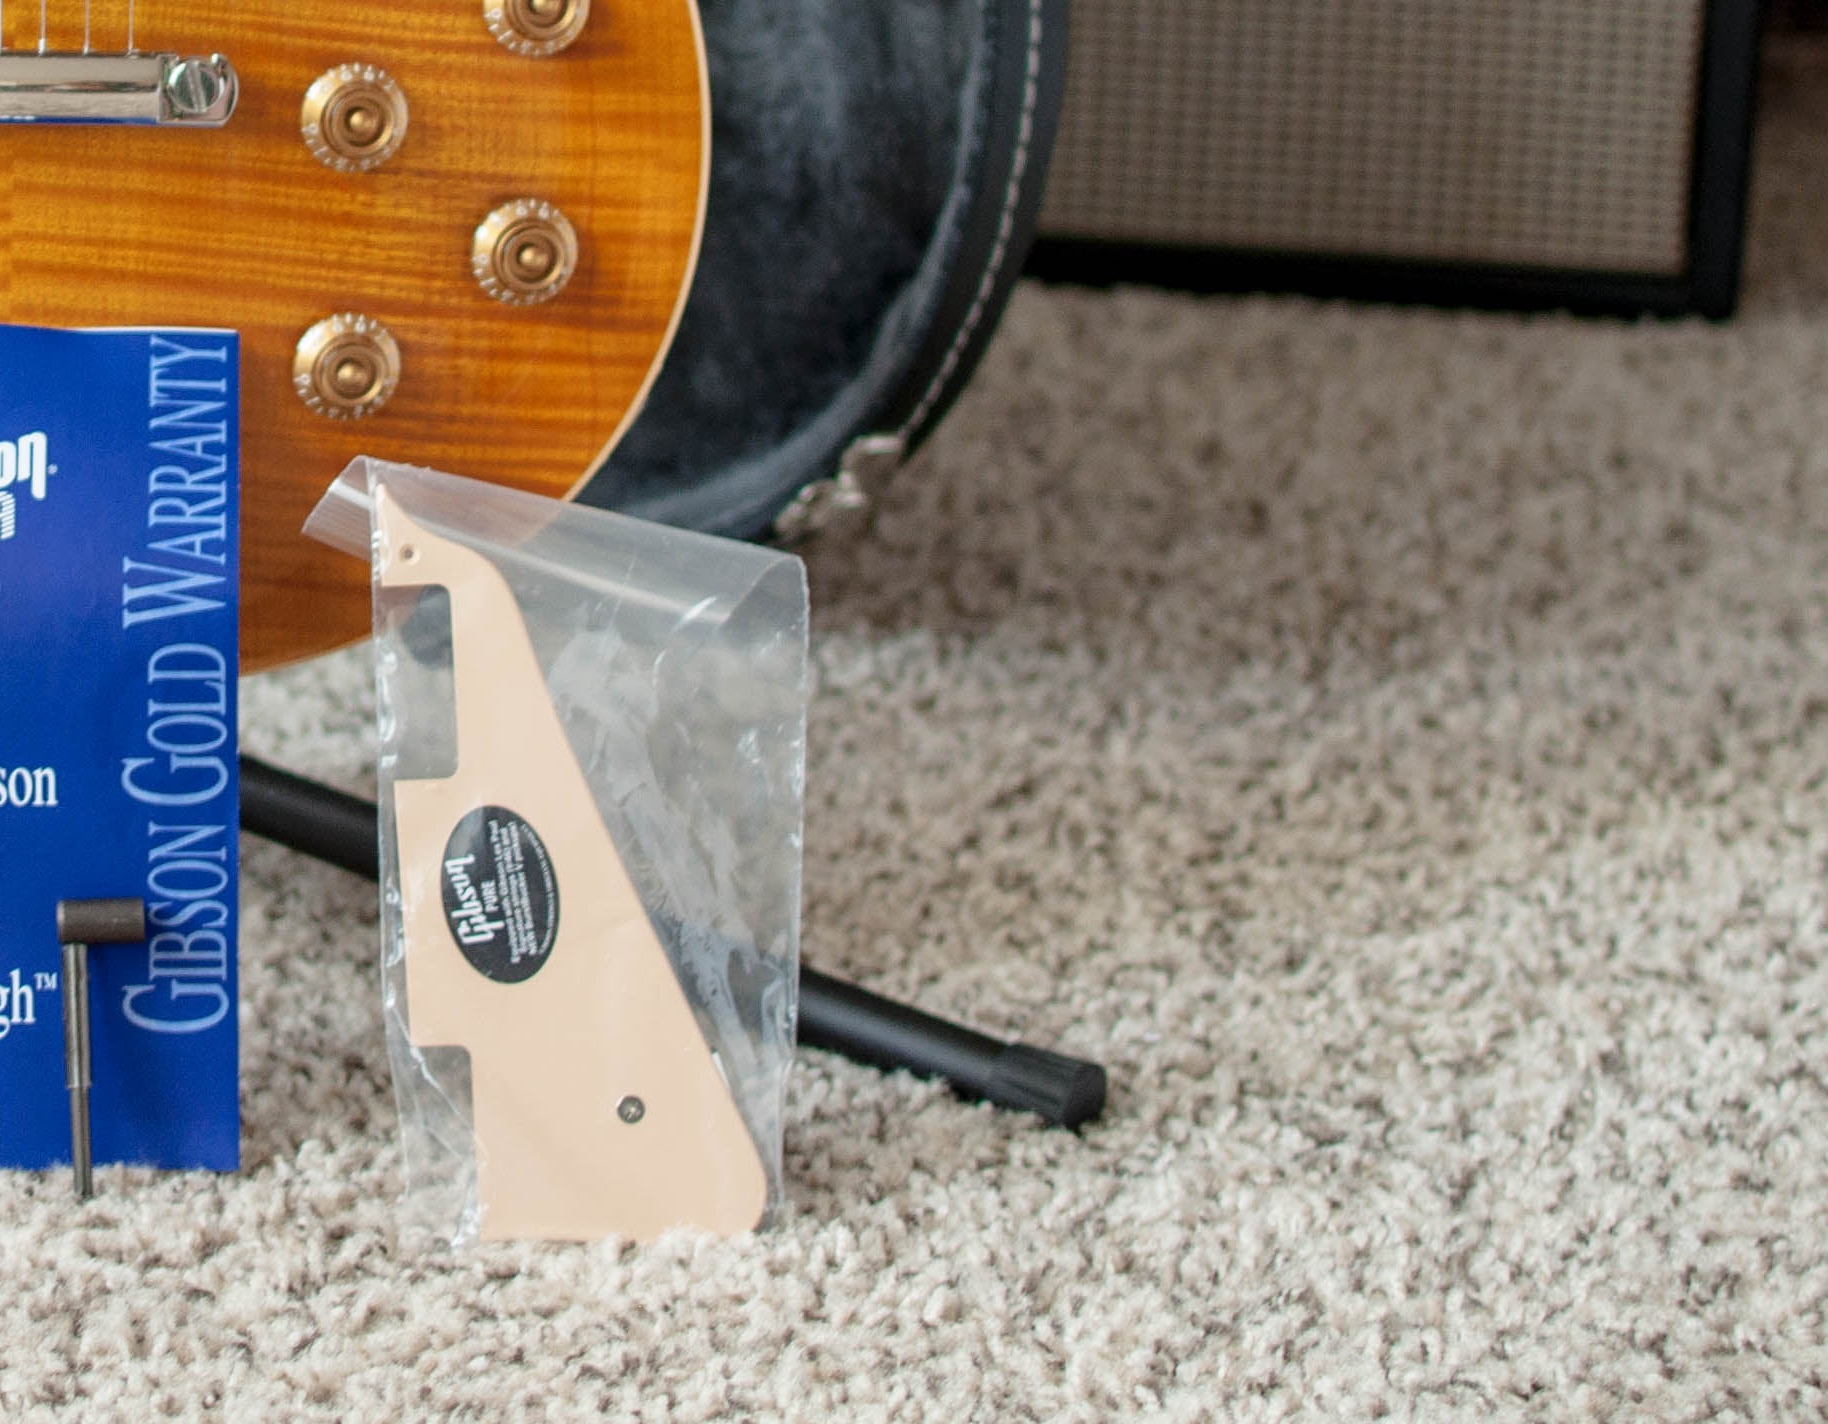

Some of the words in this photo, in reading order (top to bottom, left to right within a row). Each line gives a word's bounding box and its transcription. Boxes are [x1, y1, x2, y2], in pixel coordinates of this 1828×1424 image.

[121, 333, 228, 630] WARRANTY
[121, 642, 229, 807] GOLD
[121, 821, 230, 1035] GIBSON
[444, 853, 506, 945] Gibson
[480, 879, 500, 913] PURE
